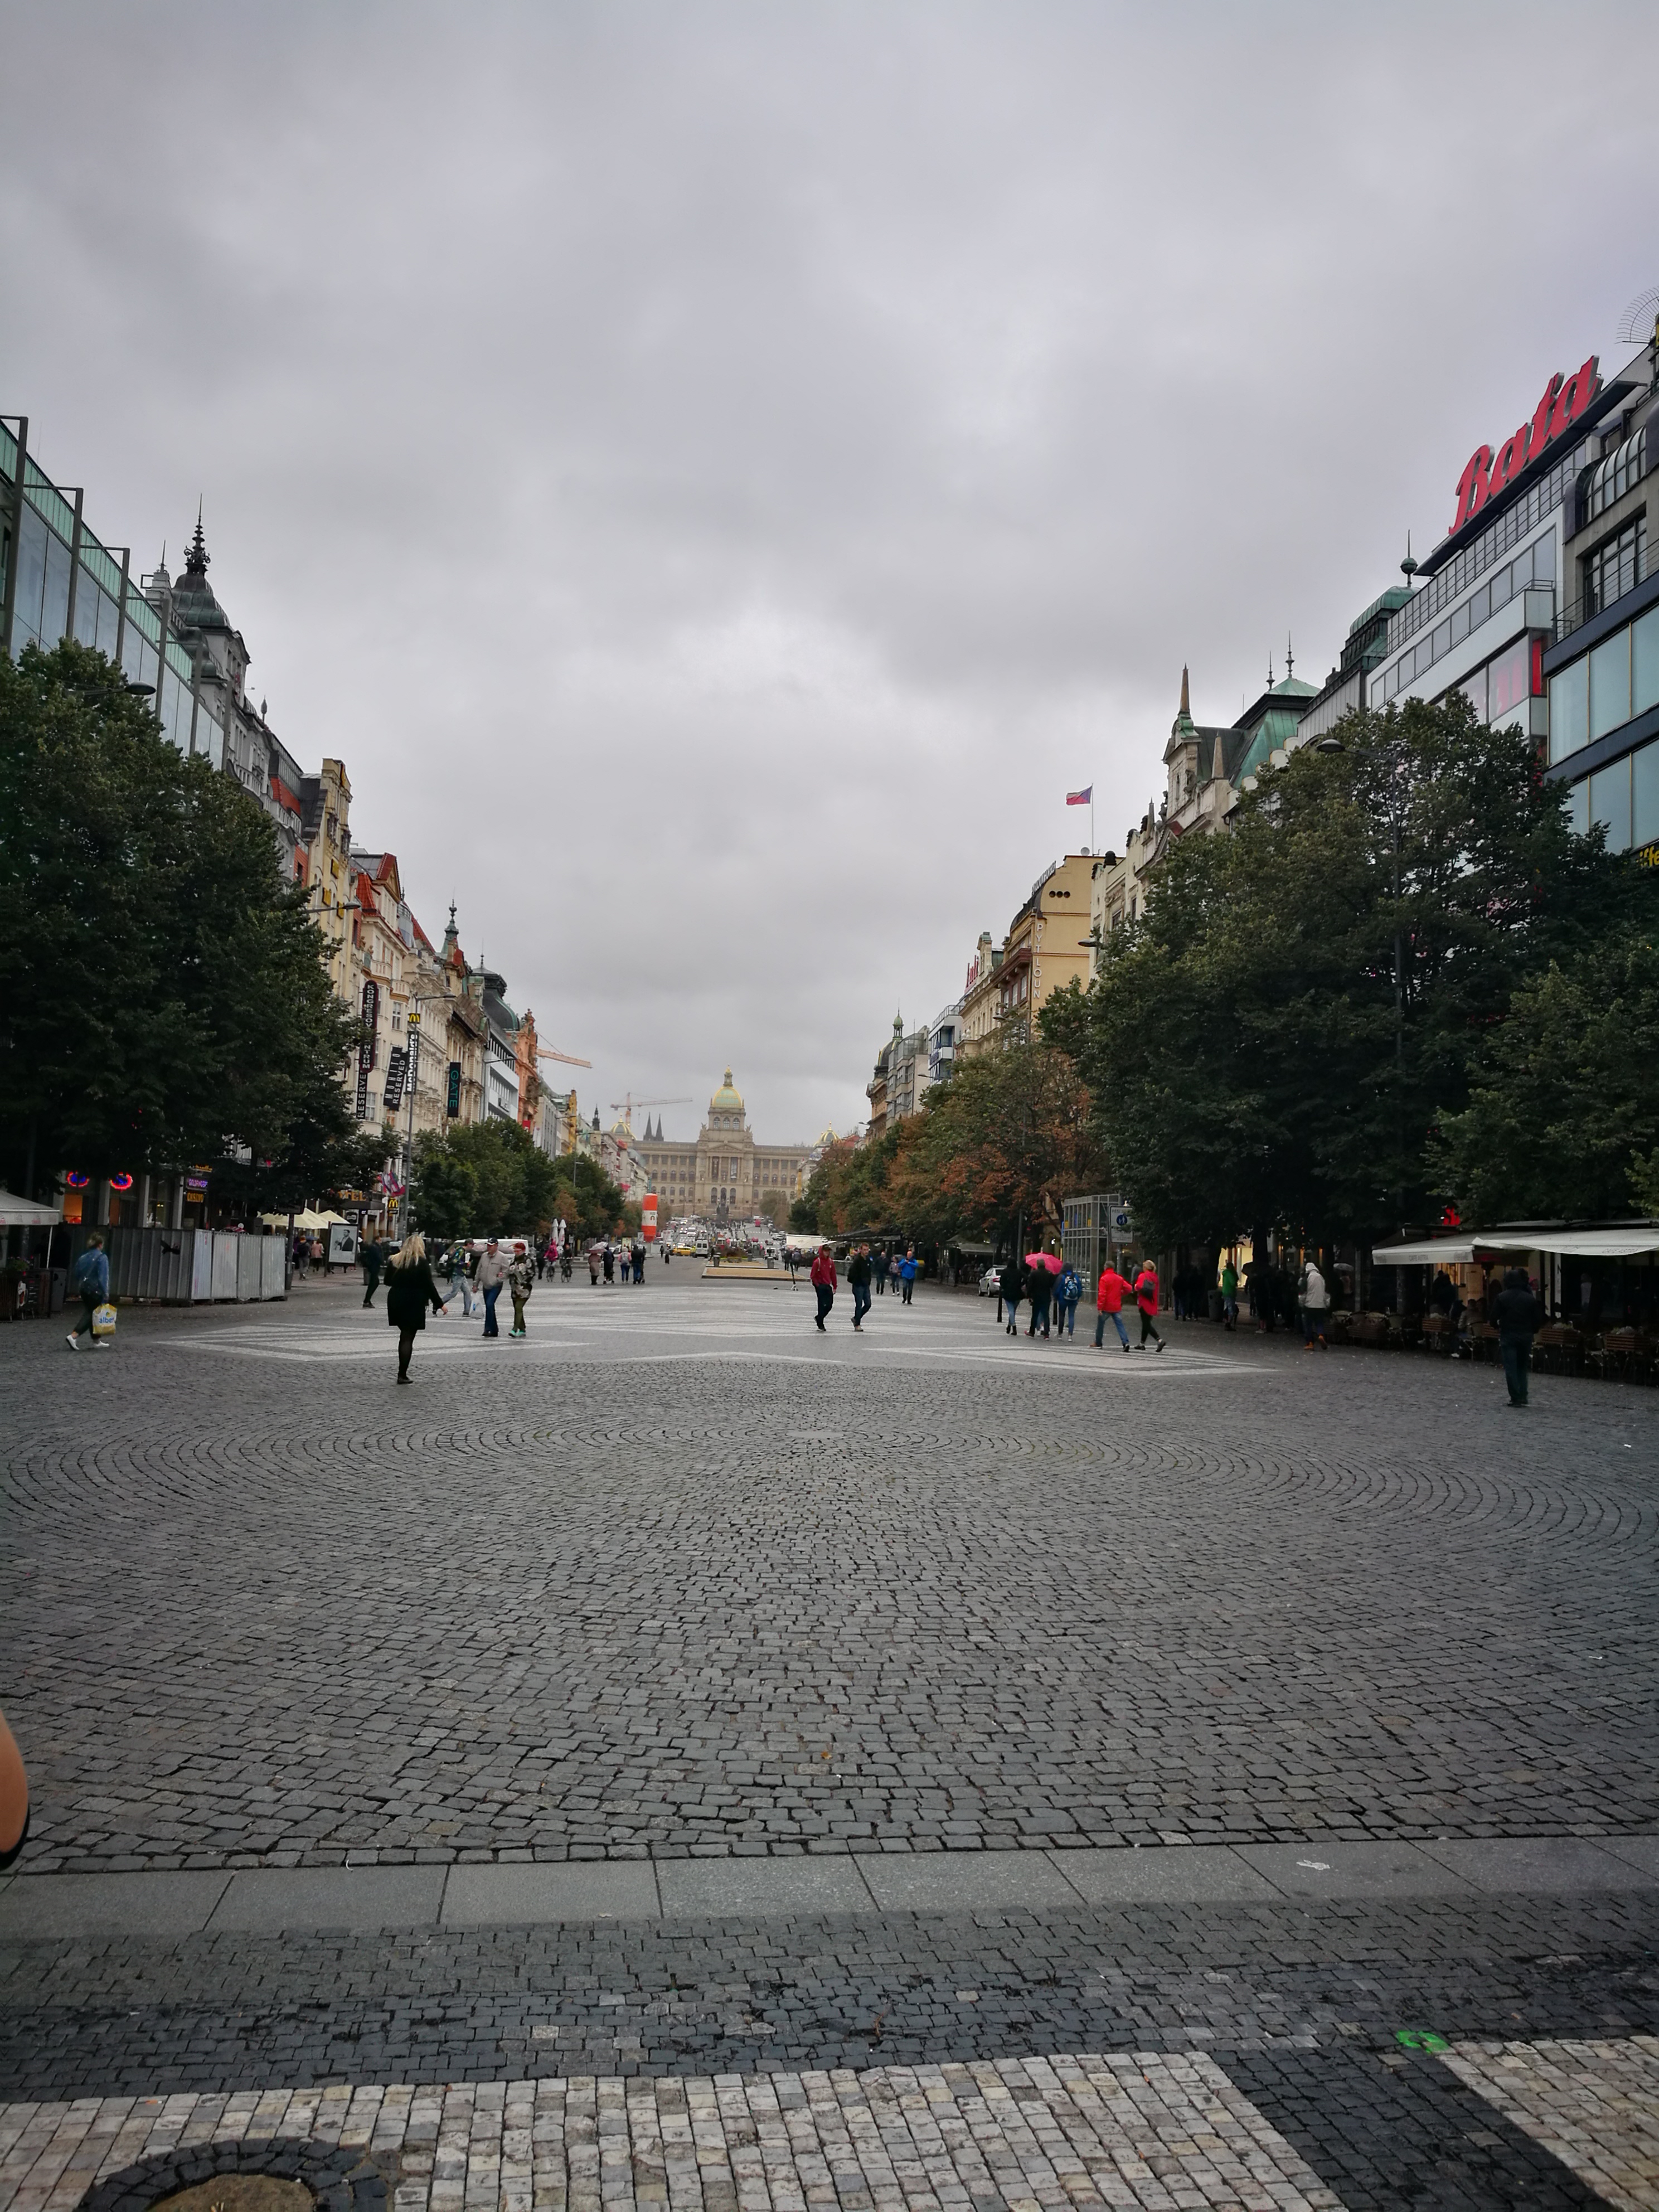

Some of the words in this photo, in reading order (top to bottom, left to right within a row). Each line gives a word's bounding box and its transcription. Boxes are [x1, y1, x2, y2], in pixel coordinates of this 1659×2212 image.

[1033, 923, 1044, 998] PYTLOUN
[365, 984, 375, 1028] KONGRESOV
[357, 1071, 366, 1118] RESERVE
[385, 1053, 401, 1099] MOHITO
[392, 1060, 406, 1104] RESERVED
[449, 1070, 459, 1108] GATE
